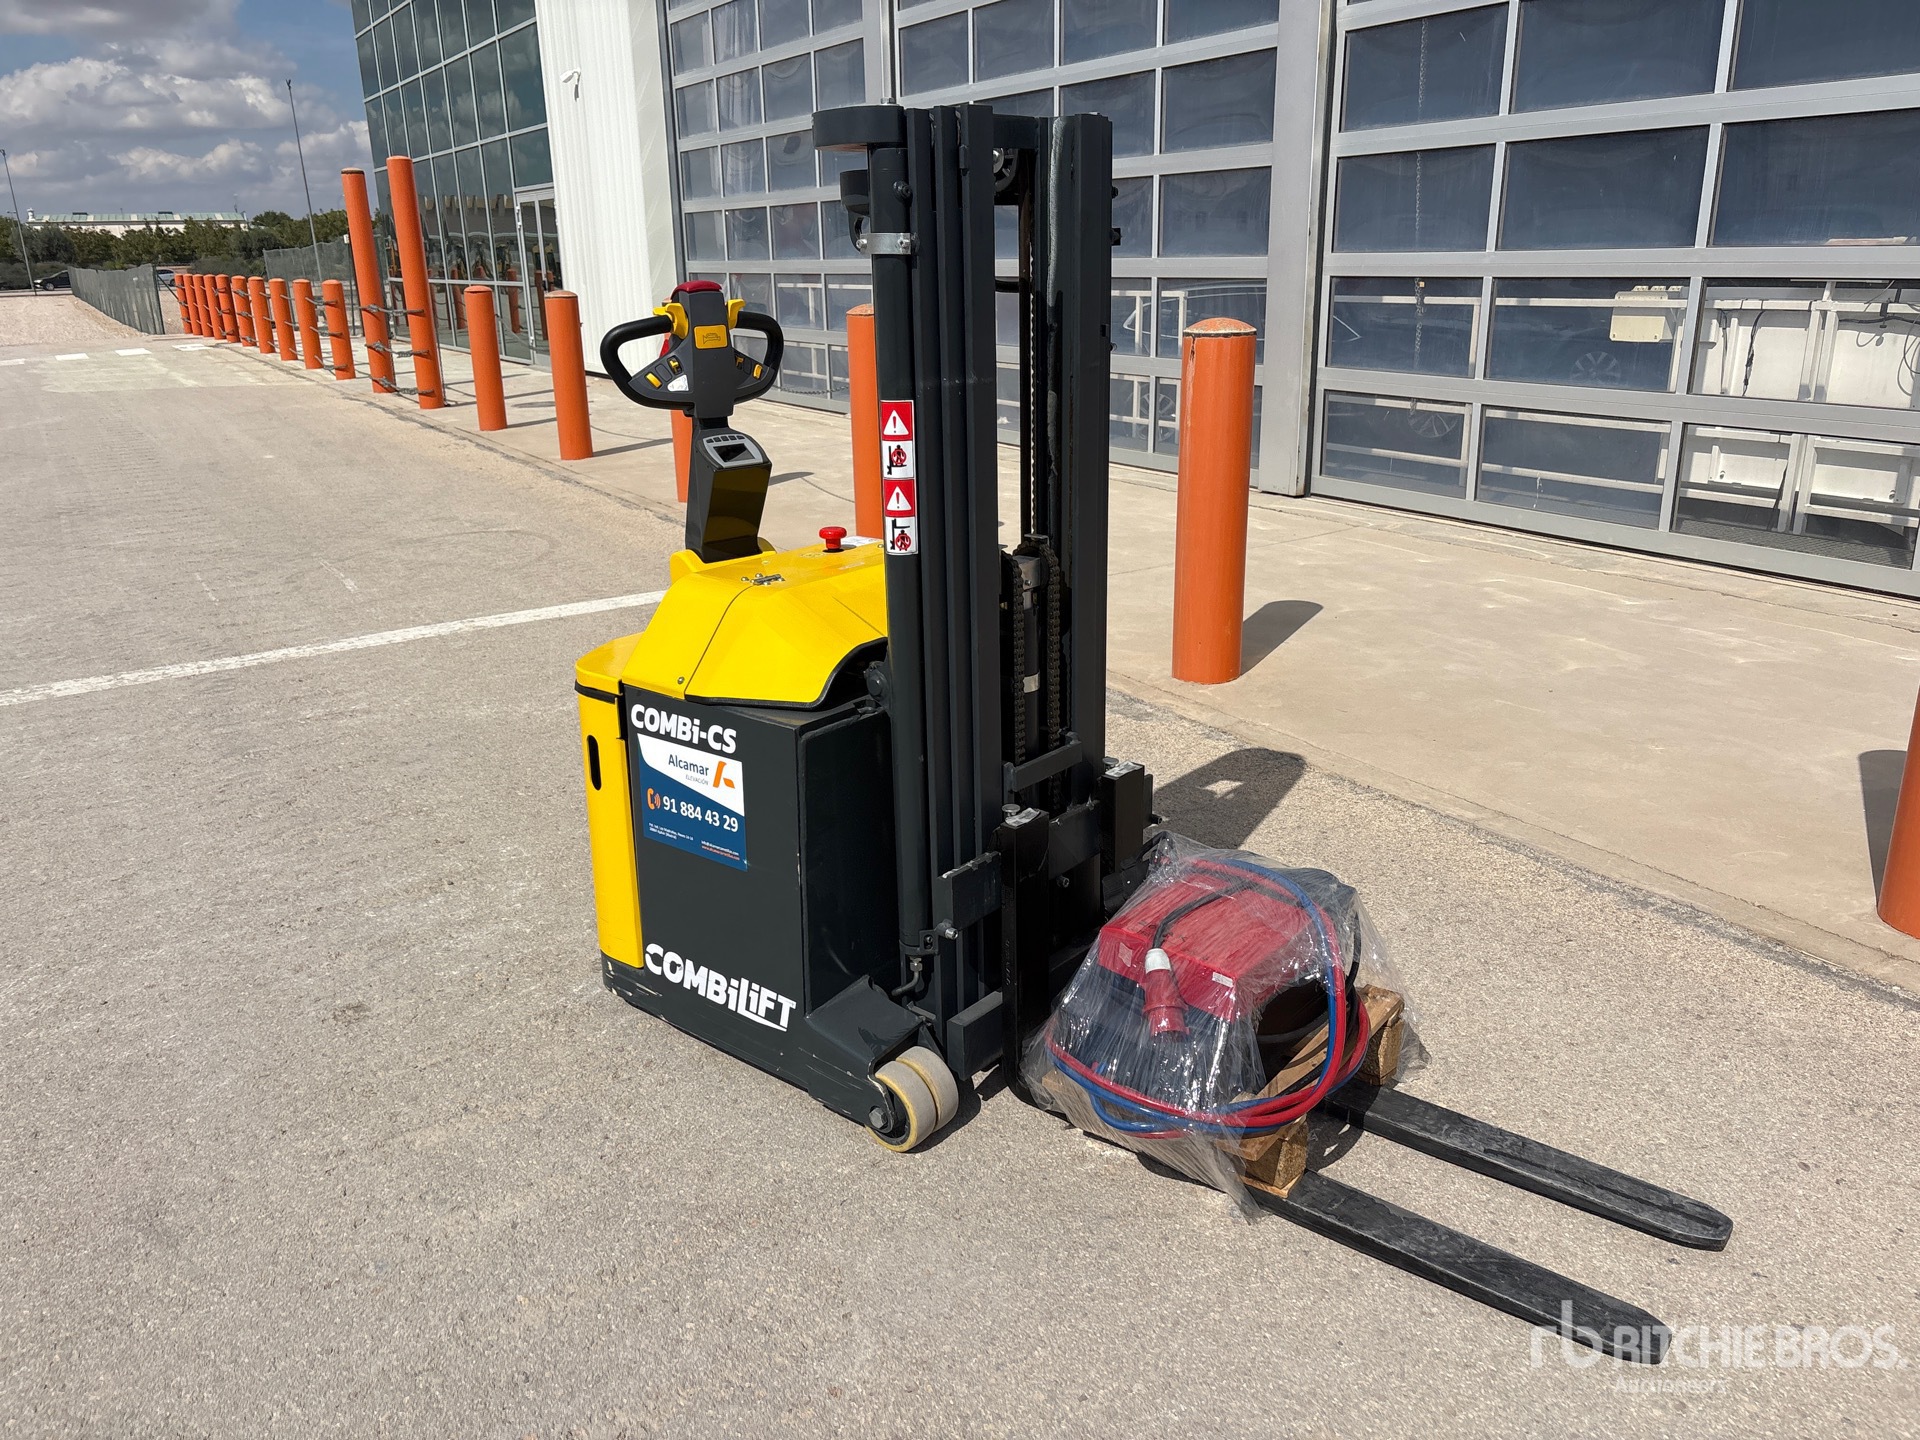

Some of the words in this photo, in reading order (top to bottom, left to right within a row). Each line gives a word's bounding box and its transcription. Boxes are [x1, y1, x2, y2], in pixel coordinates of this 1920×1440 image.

[668, 754, 709, 776] Alcamar
[663, 796, 678, 814] 91
[680, 801, 702, 821] 884
[705, 809, 720, 827] 43
[723, 815, 739, 832] 29
